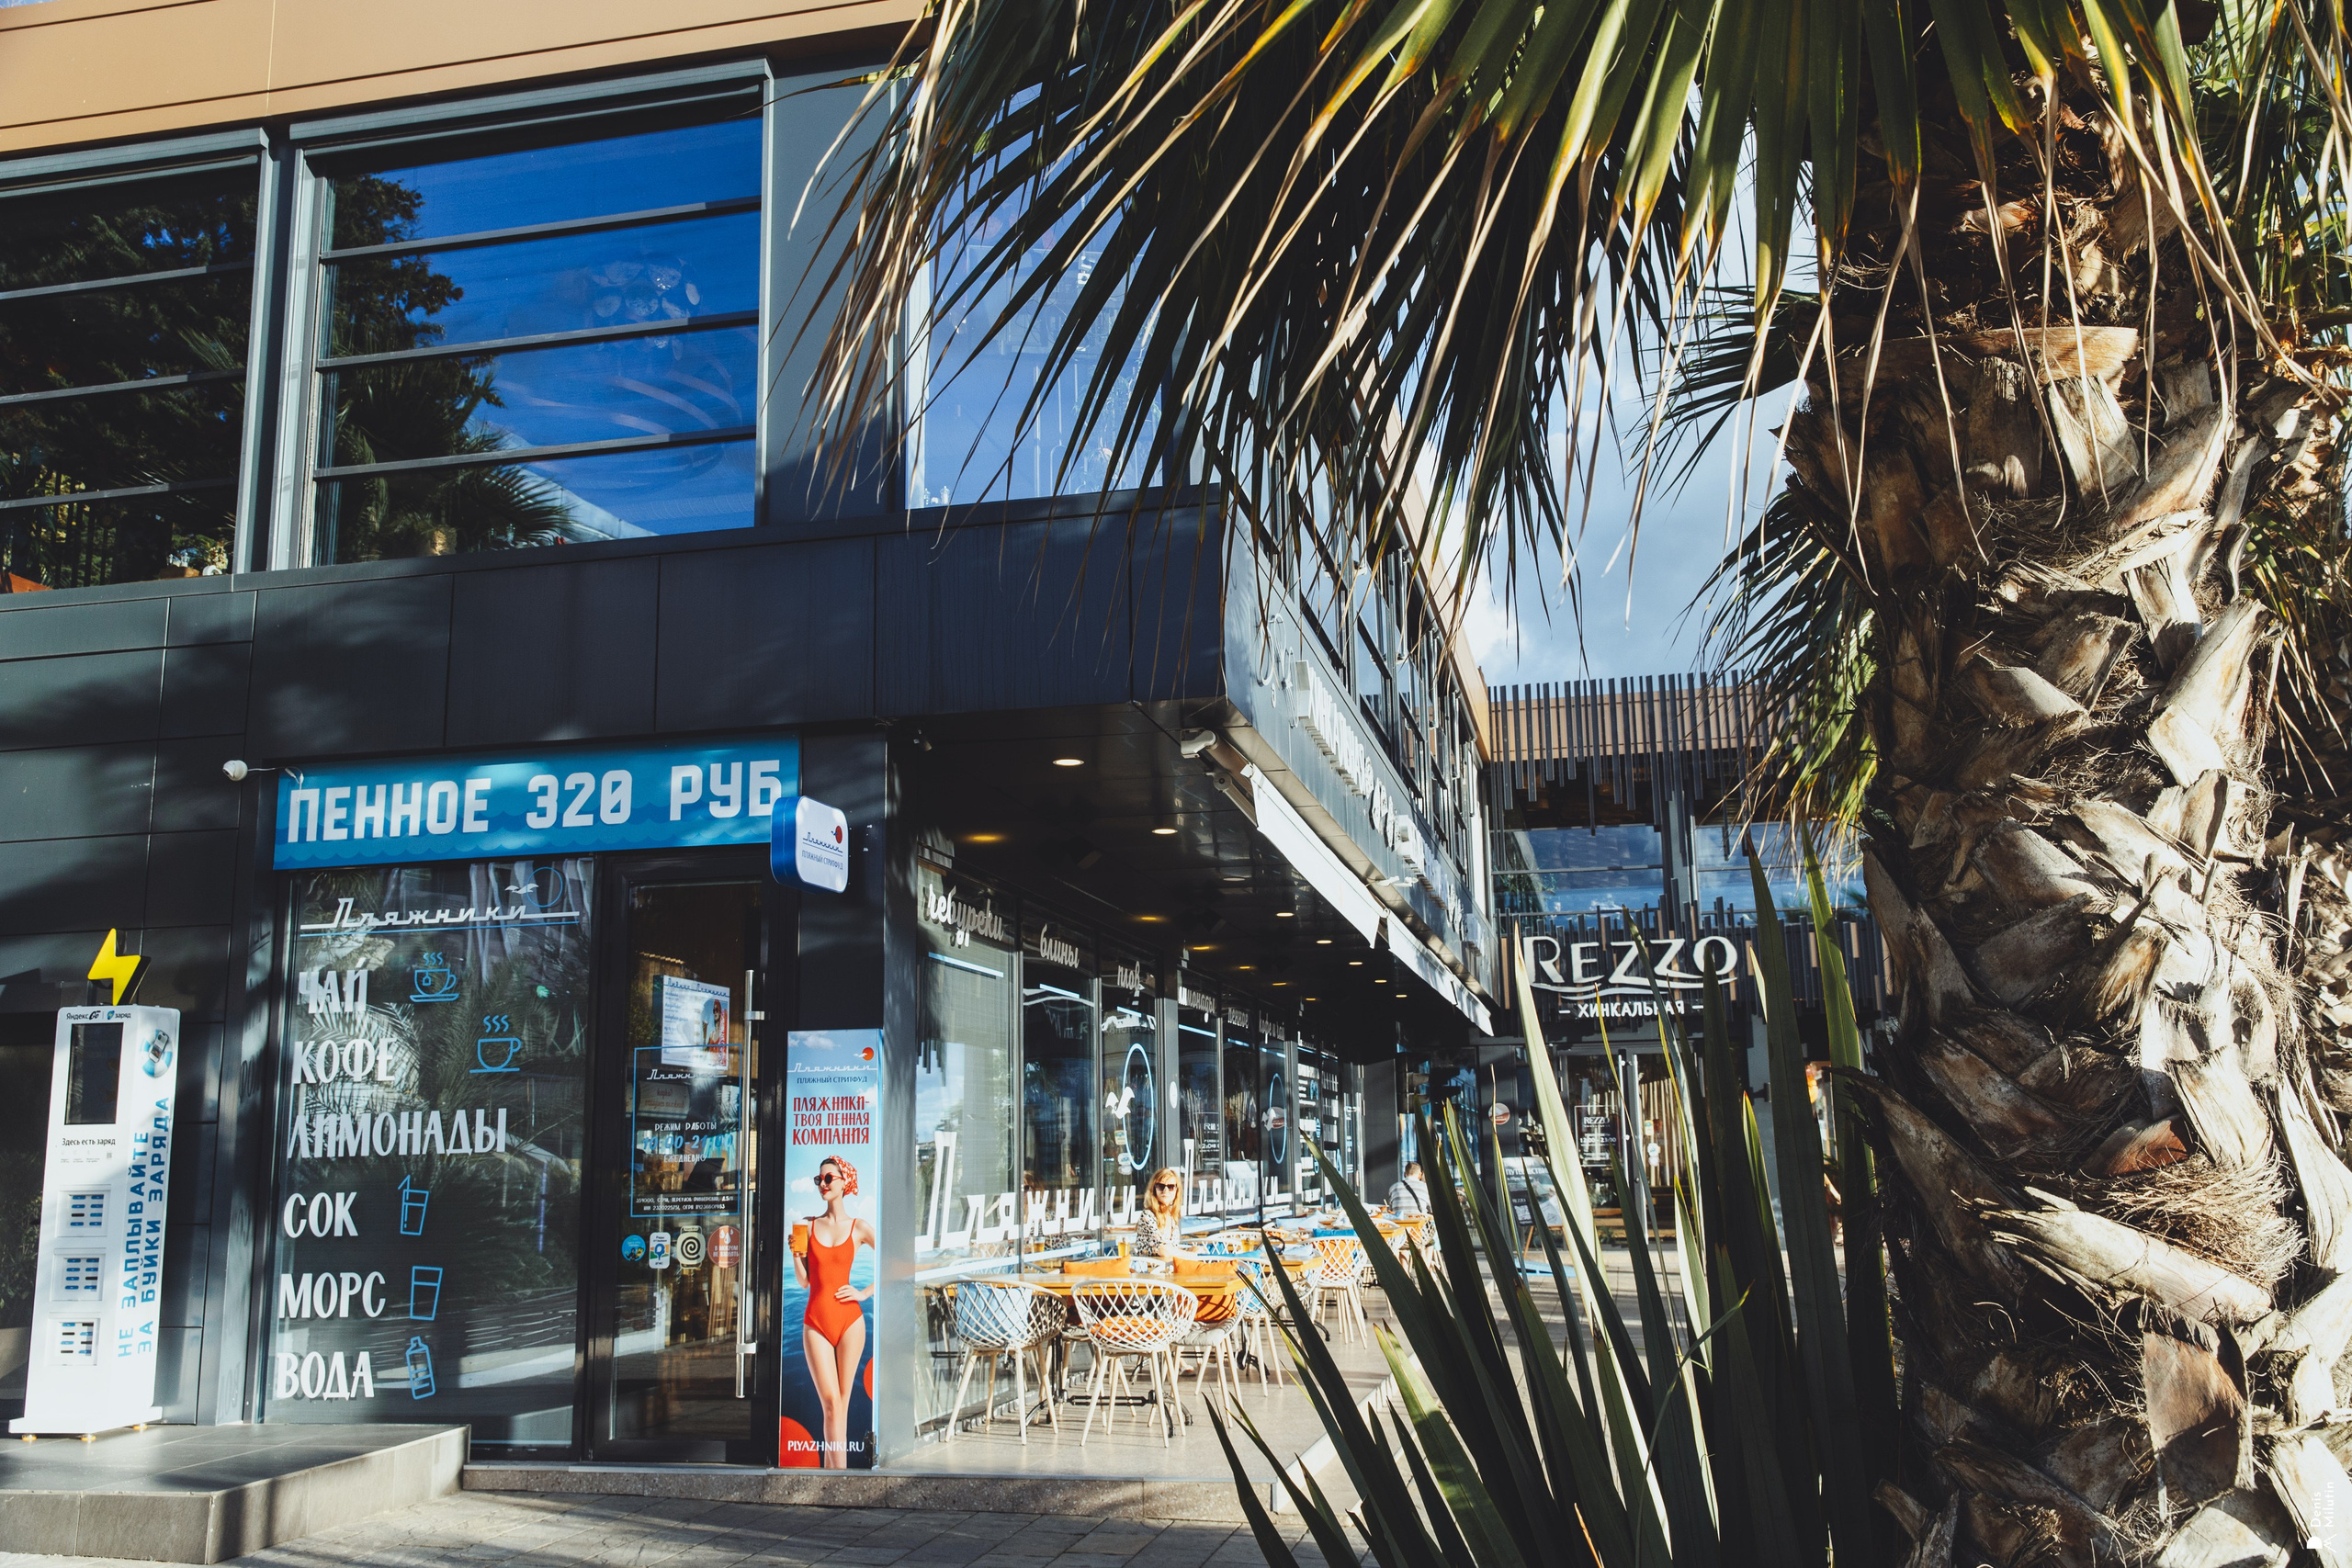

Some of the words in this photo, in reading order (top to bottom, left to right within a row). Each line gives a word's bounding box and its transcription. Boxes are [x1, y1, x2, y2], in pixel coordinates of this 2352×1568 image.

[288, 777, 491, 843] ПЕННОЕ
[526, 769, 632, 829] 320
[669, 759, 784, 821] РУБ
[801, 850, 823, 863] ПЛЯЖНЫЙ
[300, 897, 580, 931] Пляжники
[928, 884, 1004, 947] чебуреки
[1040, 923, 1080, 968] блины
[1117, 961, 1140, 991] плов
[1522, 935, 1738, 992] REZZO
[298, 957, 368, 1014] ЧАЙ
[66, 1012, 89, 1021] Яндекс
[115, 1012, 131, 1021] заряд
[291, 1038, 396, 1084] КОФЕ
[787, 1063, 877, 1073] Пляжники
[797, 1076, 832, 1084] ПЛЯЖНЫЙ
[832, 1076, 868, 1084] СТРИТФУД
[793, 1096, 870, 1111] ПЛЯЖНИКИ-
[794, 1113, 822, 1127] ТВОЯ
[827, 1112, 870, 1126] ПЕННАЯ
[62, 1138, 81, 1147] Здесь
[96, 1137, 116, 1146] заряд
[287, 1108, 507, 1159] ЛИМОНАДЫ
[654, 1122, 681, 1132] РЕЖИМ
[685, 1122, 717, 1131] РАБОТЫ
[793, 1127, 869, 1145] КОМПАНИЯ
[149, 1098, 170, 1202] ЗАРЯДА
[663, 1154, 707, 1163] ЕЖЕДНЕВНО
[915, 1131, 1144, 1252] Пляжники
[121, 1132, 149, 1309] ЗАПЛЫВАЙТЕ
[283, 1191, 358, 1239] СОК
[140, 1220, 161, 1303] БУЙКИ
[279, 1271, 386, 1319] МОРС
[118, 1327, 134, 1358] НЕ
[138, 1321, 153, 1354] ЗА
[277, 1350, 375, 1401] ВОДА
[787, 1440, 865, 1453] PLYAZHNIKI.RU
